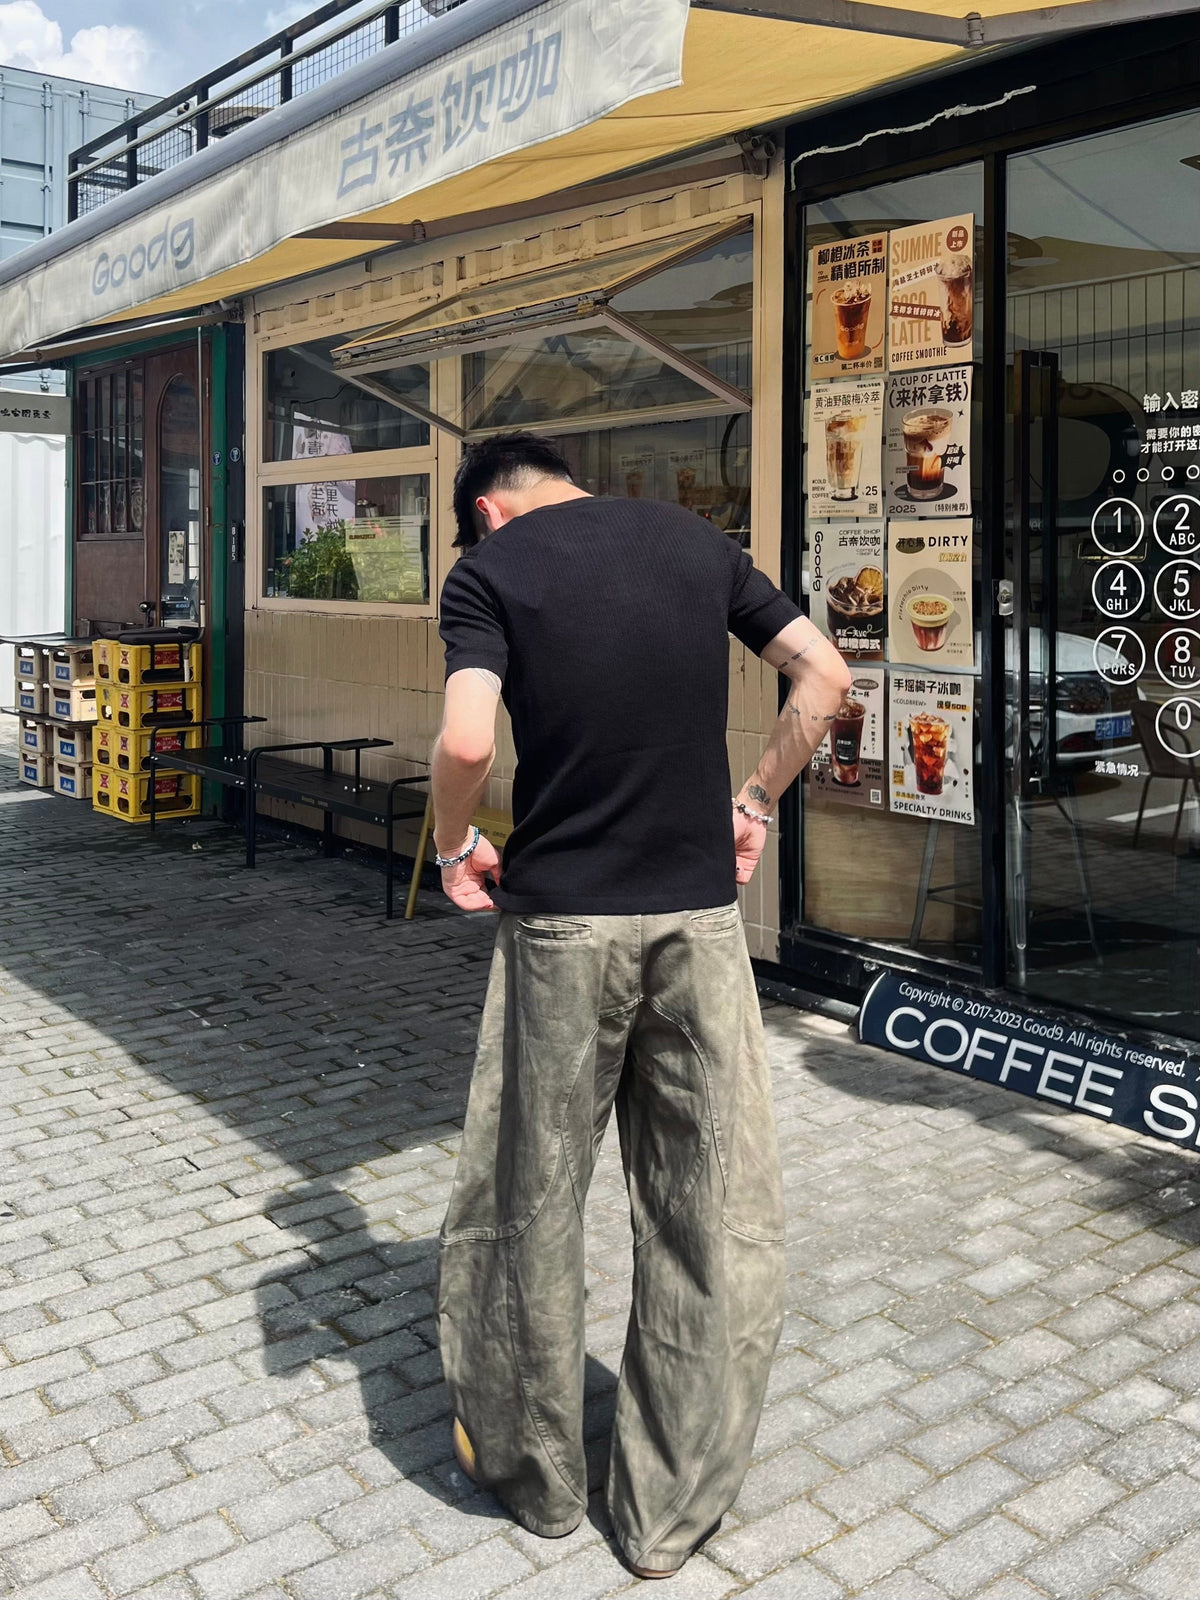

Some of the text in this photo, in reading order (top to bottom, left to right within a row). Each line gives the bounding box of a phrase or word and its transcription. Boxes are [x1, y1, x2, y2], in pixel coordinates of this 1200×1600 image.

[337, 28, 562, 199] 古奈饮咖
[892, 232, 943, 265] SUMME
[891, 319, 931, 347] LATTE
[892, 346, 947, 363] COFFEE SMOOTHIE
[892, 378, 898, 388] A
[900, 375, 918, 386] CUP
[921, 373, 933, 383] OF
[936, 369, 967, 382] LATTE
[889, 381, 969, 408] (来杯拿铁)
[1140, 438, 1200, 454] 才能打开这
[889, 505, 917, 514] 2025
[1113, 507, 1122, 533] 1
[1174, 503, 1190, 530] 2
[929, 535, 968, 547] DIRTY
[1169, 533, 1195, 545] ABC
[1110, 569, 1127, 596] 4
[1173, 570, 1190, 597] 5
[1106, 598, 1128, 611] GHI
[1169, 599, 1195, 612] JKL
[1111, 634, 1127, 660] 7
[1174, 636, 1191, 664] 8
[1103, 663, 1136, 676] PQRS
[1170, 665, 1196, 678] TUV
[1175, 702, 1192, 730] 0
[1095, 760, 1139, 777] 紧急情况
[893, 801, 972, 821] SPECIALTY DRINKS
[899, 981, 951, 1008] Copyright
[964, 1001, 1021, 1029] 2017-2023
[1023, 1018, 1064, 1043] Good9.
[1067, 1028, 1084, 1047] All
[1086, 1033, 1122, 1059] rights
[1125, 1050, 1186, 1078] reserved.
[885, 1006, 1200, 1147] COFFEE S
